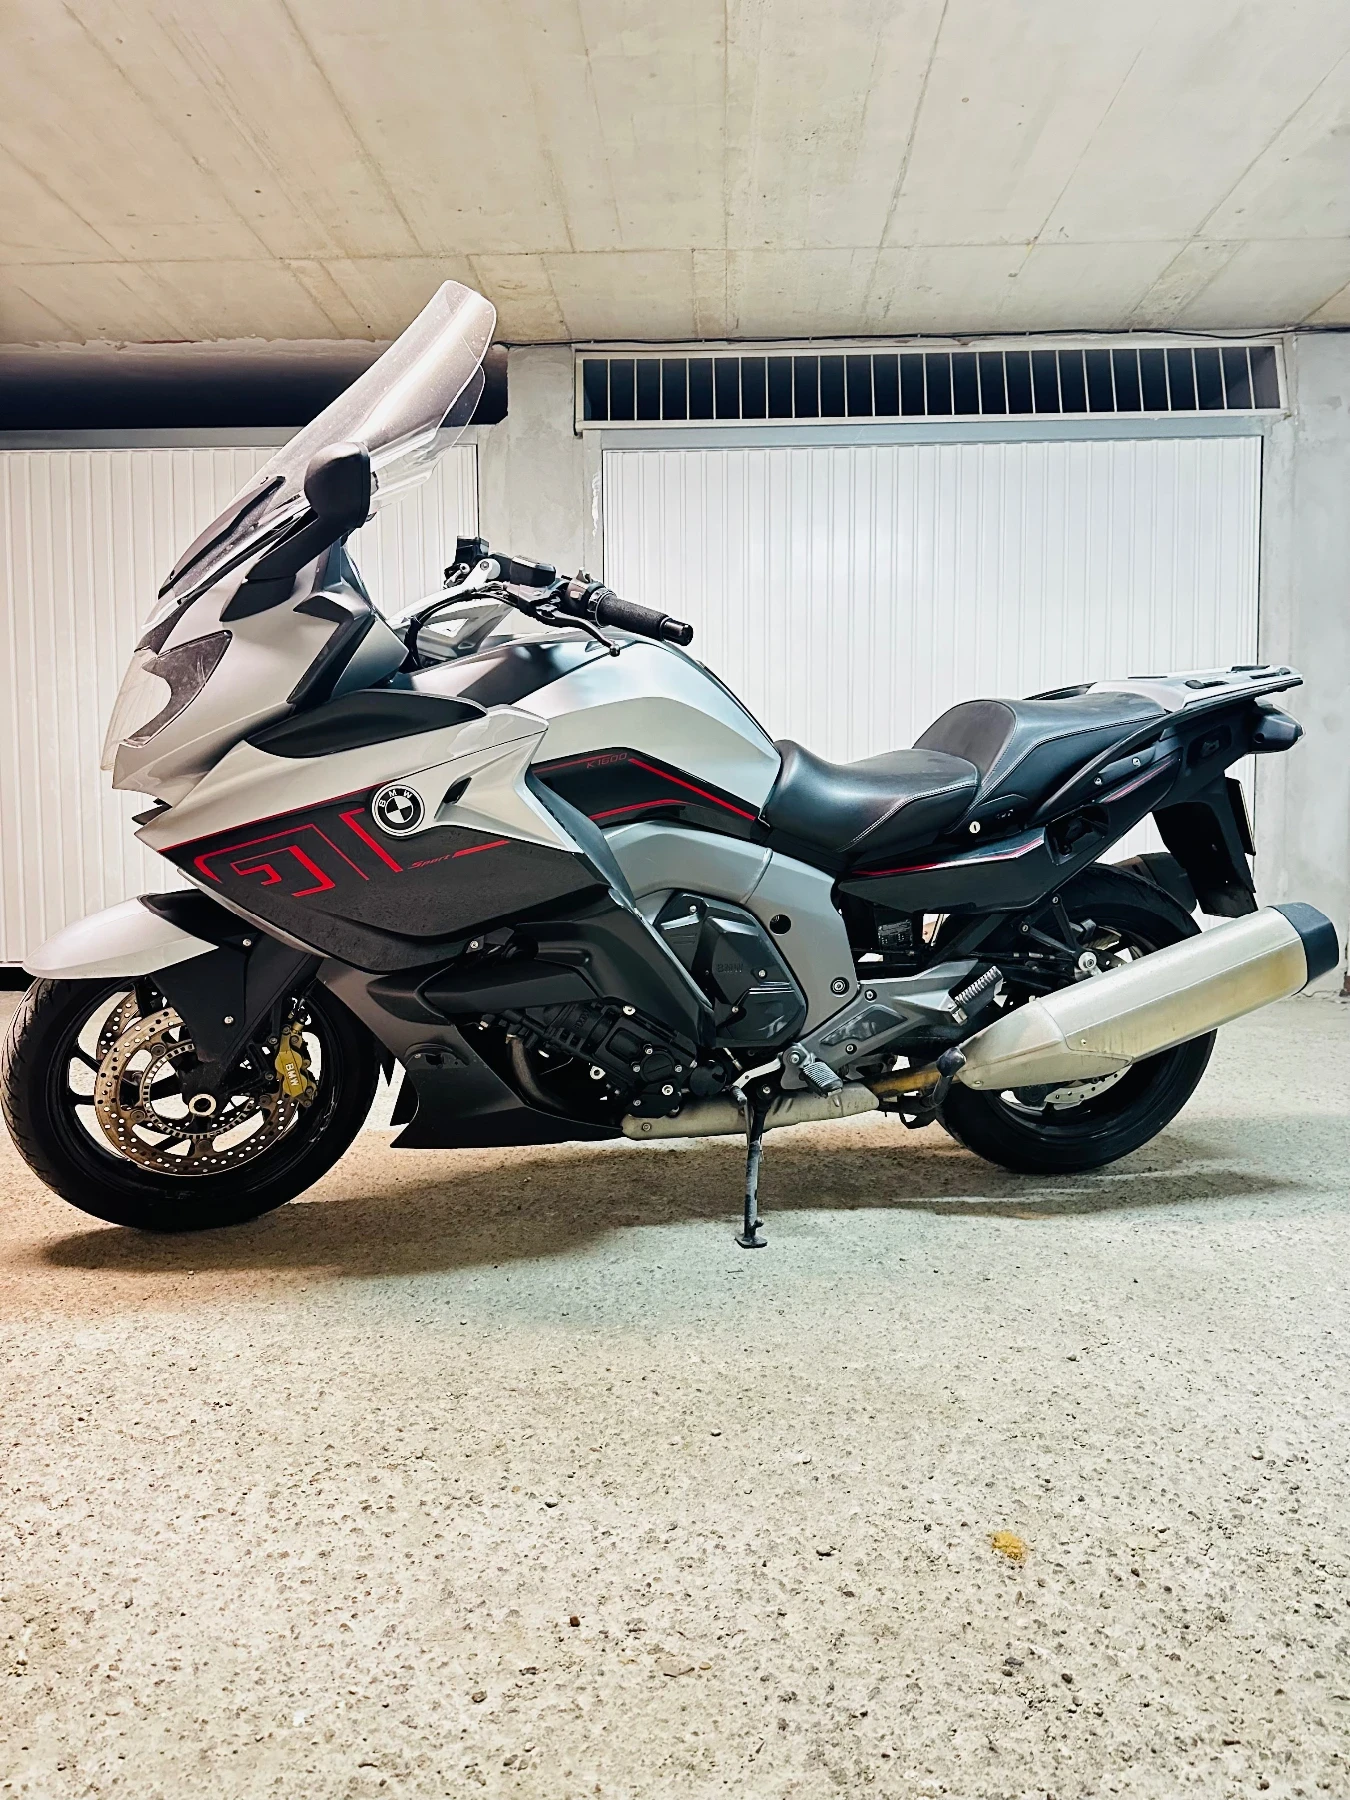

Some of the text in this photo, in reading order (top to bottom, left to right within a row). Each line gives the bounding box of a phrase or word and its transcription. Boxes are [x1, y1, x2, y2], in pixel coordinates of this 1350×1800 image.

[378, 789, 413, 808] BMW
[407, 854, 451, 870] Sport
[285, 1063, 300, 1086] BMW
